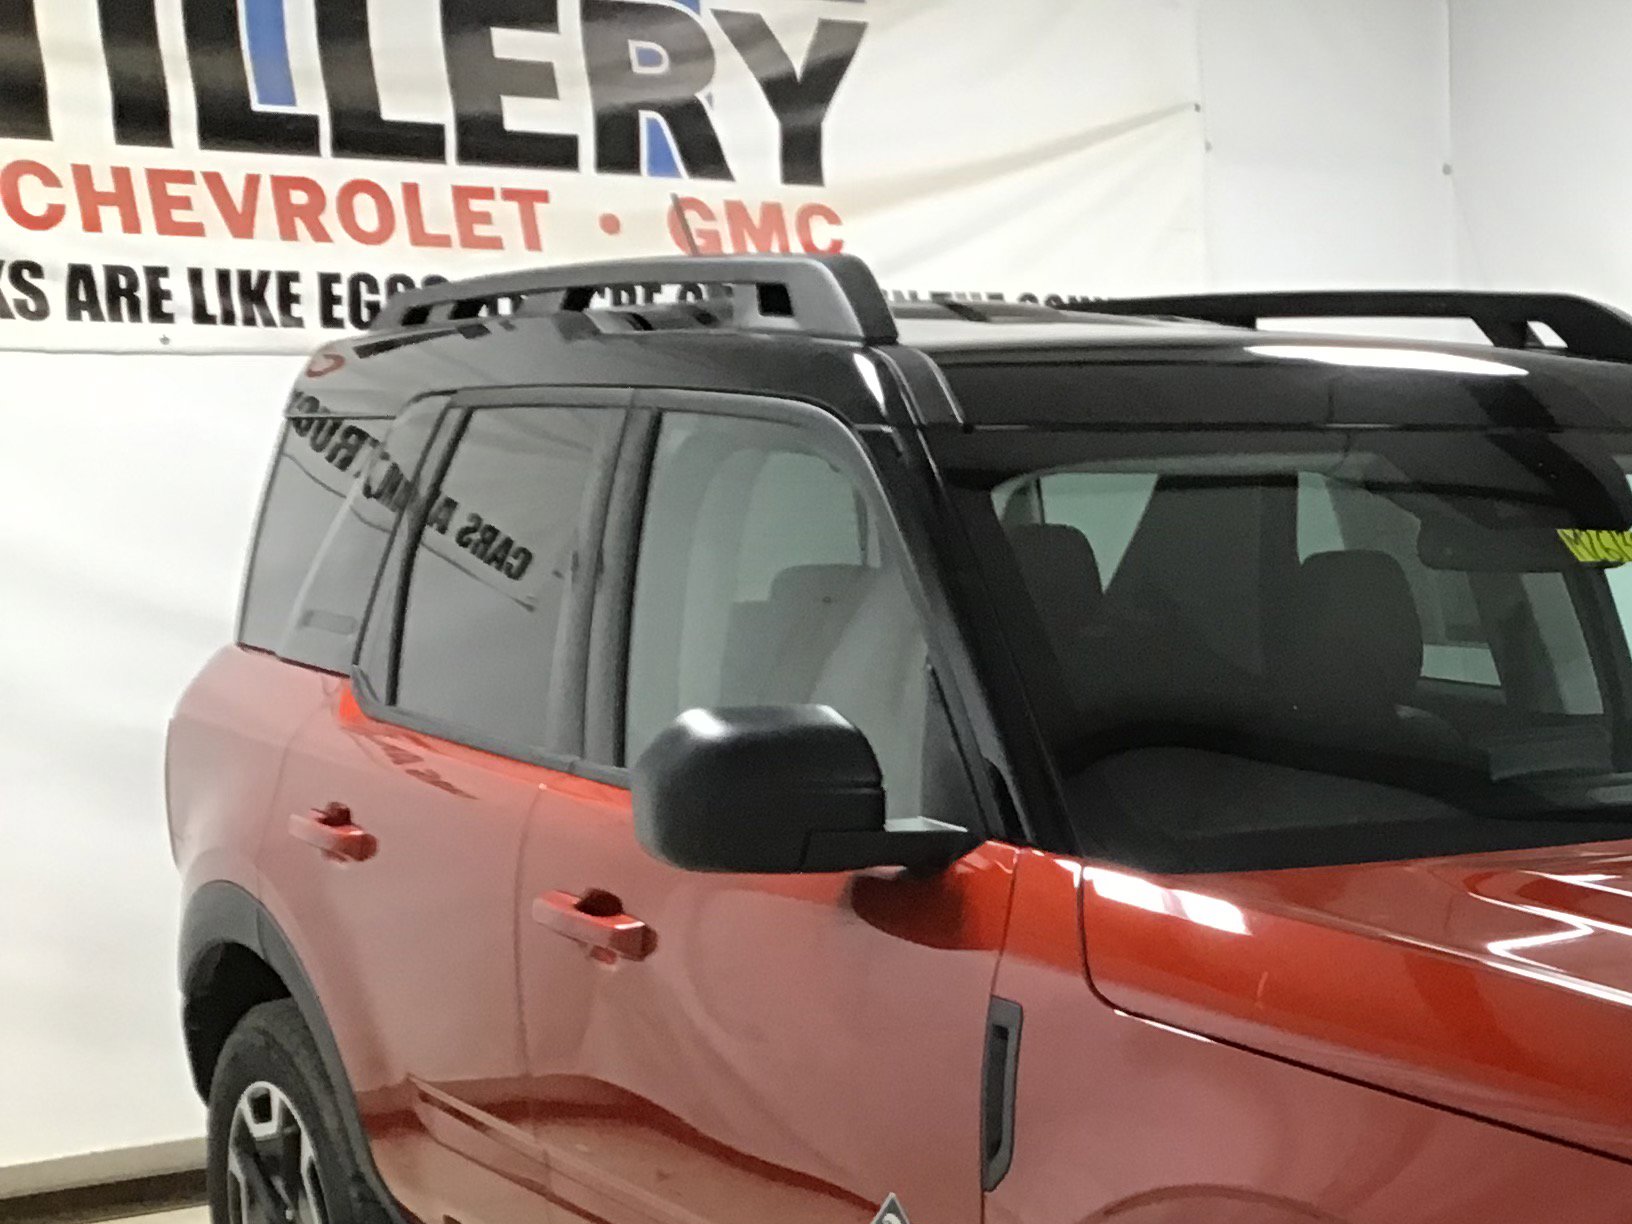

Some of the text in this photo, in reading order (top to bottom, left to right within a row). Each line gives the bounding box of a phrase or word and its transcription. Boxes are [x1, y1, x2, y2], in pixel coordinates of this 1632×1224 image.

[0, 159, 844, 256] CHEVROLET GMC
[0, 260, 50, 321] S
[67, 263, 175, 325] ARE
[187, 267, 305, 329] LIKE
